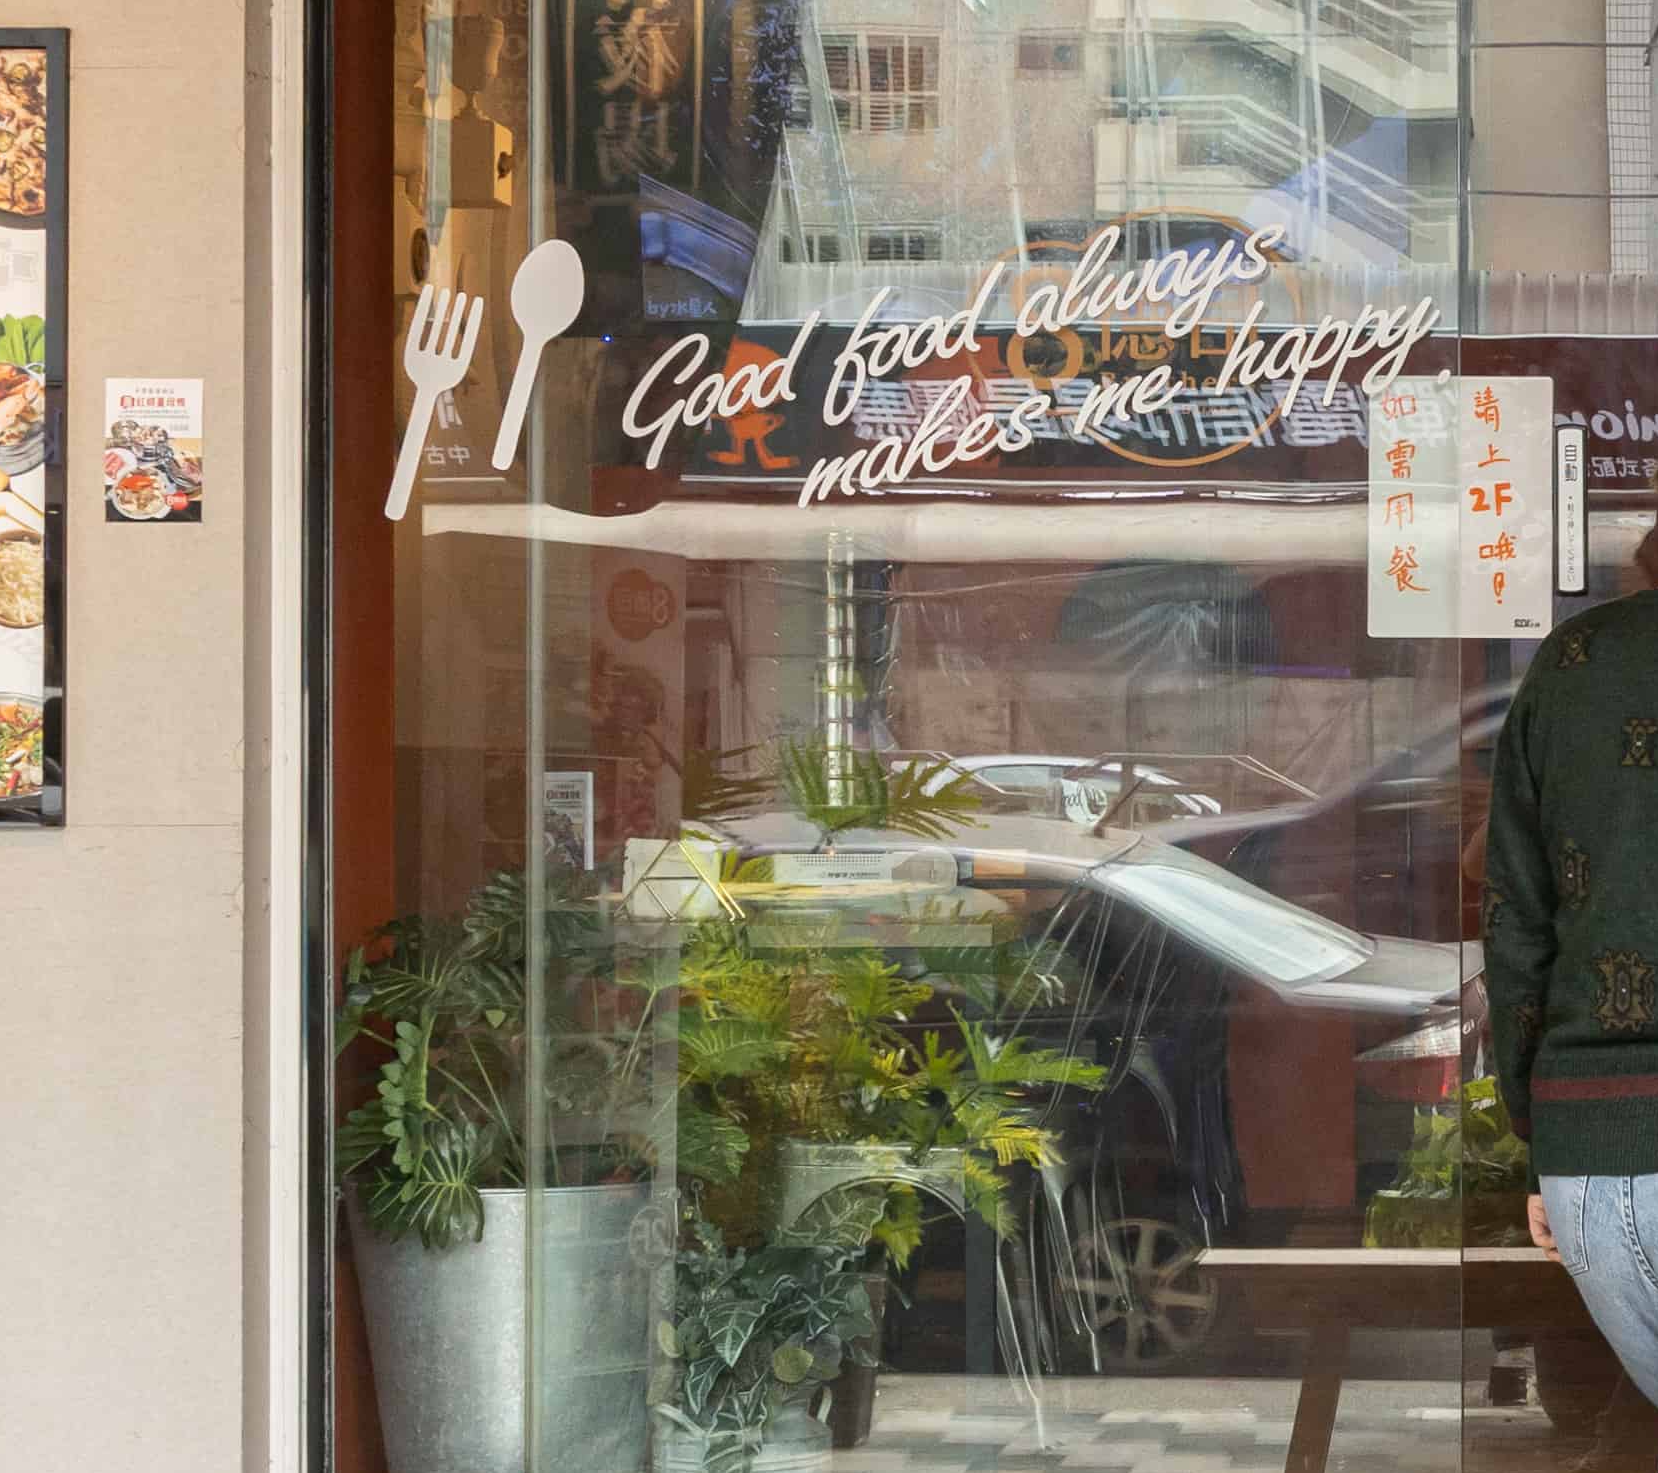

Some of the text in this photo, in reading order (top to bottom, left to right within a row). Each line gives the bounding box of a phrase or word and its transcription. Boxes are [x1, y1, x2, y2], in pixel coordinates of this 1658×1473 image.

[622, 224, 1287, 469] Good food always
[798, 375, 1050, 508] makes
[1075, 364, 1184, 433] me
[1381, 392, 1430, 592] 如需用餐
